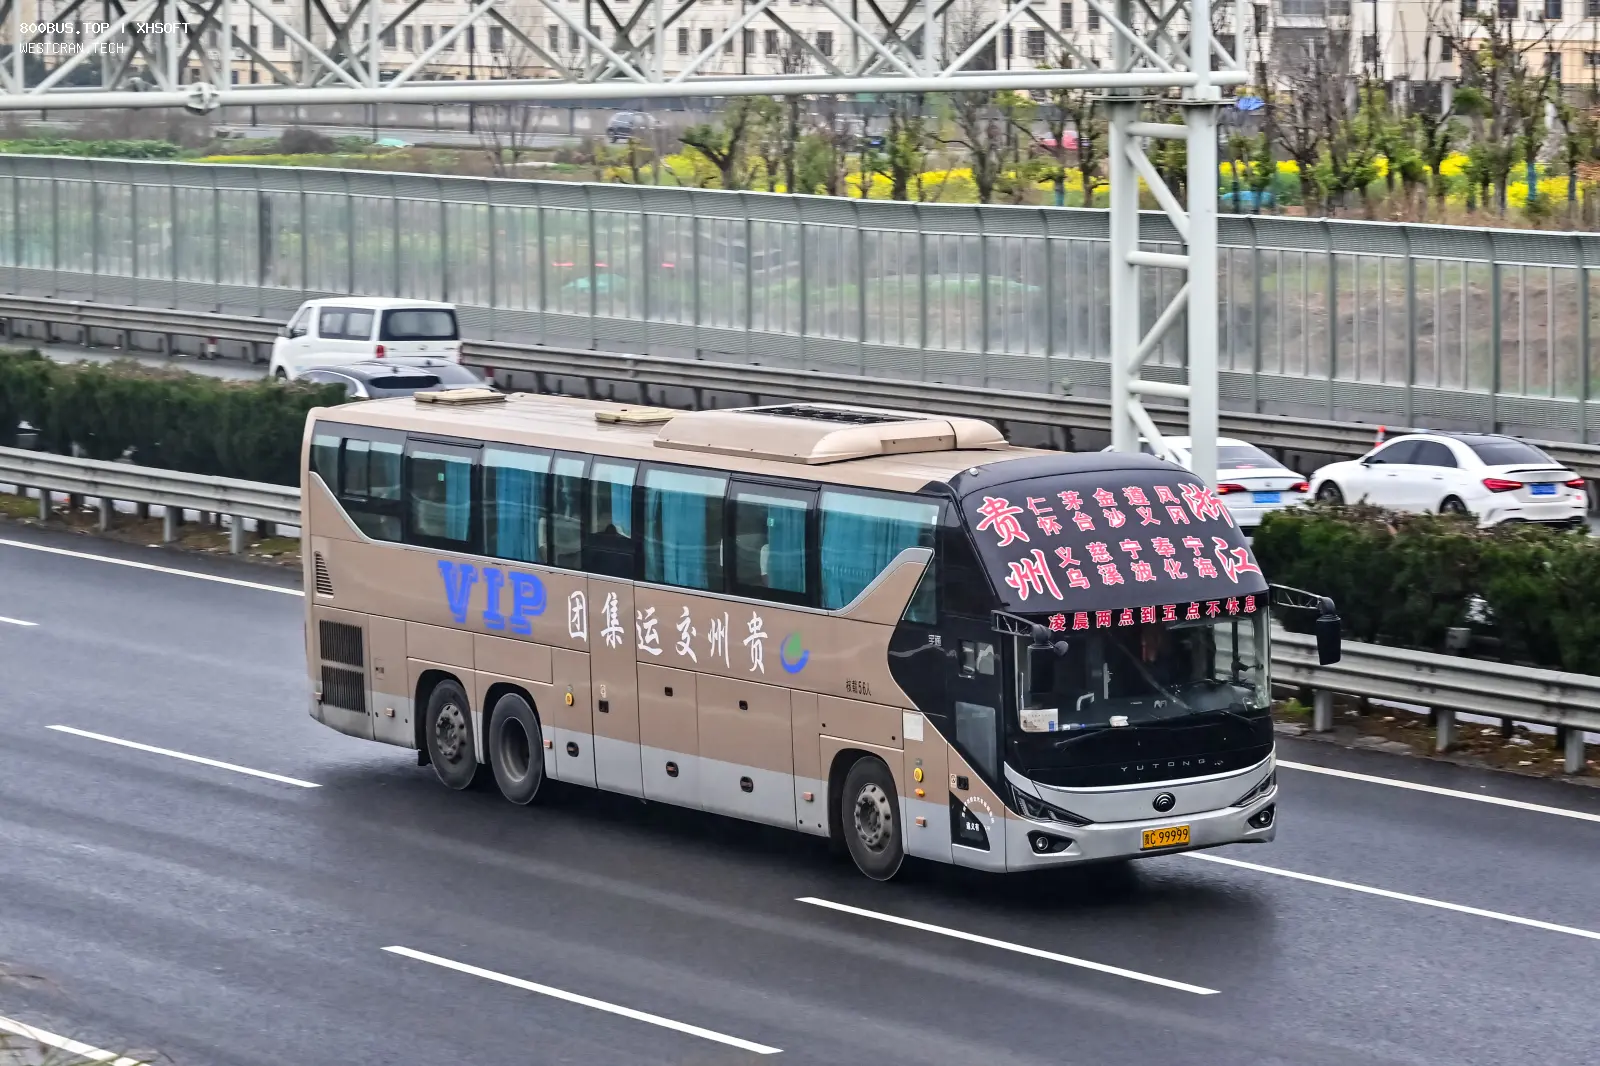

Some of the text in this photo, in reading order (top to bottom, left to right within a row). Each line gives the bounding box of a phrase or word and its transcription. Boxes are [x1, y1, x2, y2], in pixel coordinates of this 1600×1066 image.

[1026, 495, 1063, 536] 仁怀
[1057, 490, 1096, 533] 茅台
[1092, 487, 1127, 529] 金沙
[1122, 485, 1161, 527] 遵义
[1153, 485, 1191, 526] 凤冈
[1054, 546, 1091, 591] 义乌
[1085, 541, 1125, 586] 慈溪
[1119, 538, 1157, 583] 宁波
[1152, 536, 1188, 581] 奉化
[1182, 535, 1219, 580] 宁海
[437, 560, 548, 636] VIP
[1048, 595, 1257, 632] 凌晨两点到五点不休息
[928, 634, 942, 647] 宇通
[1120, 758, 1206, 772] YUTONG
